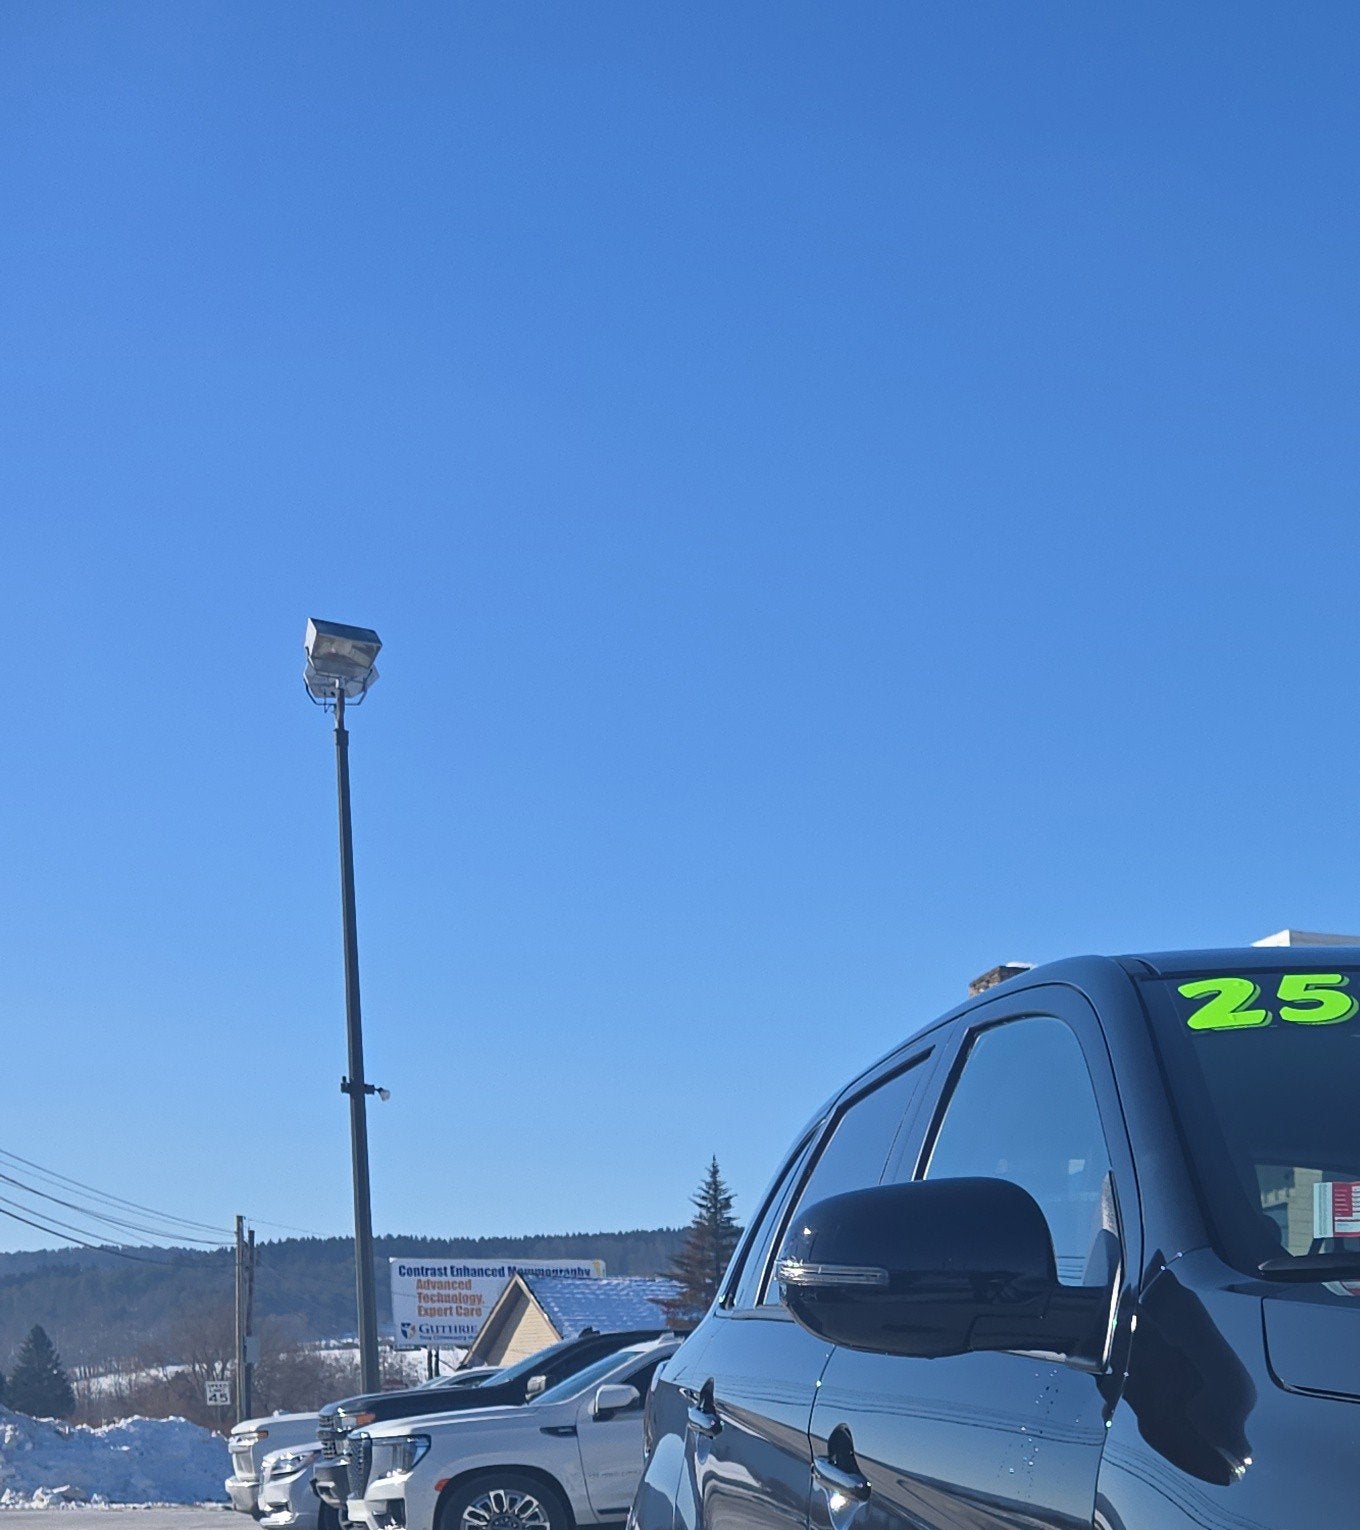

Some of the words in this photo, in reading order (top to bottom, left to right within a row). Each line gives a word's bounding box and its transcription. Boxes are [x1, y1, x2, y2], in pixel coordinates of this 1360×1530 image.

[1178, 973, 1359, 1030] 25
[399, 1265, 448, 1277] Contrast
[450, 1265, 505, 1277] Enhanced
[416, 1279, 472, 1290] Advanced
[417, 1305, 453, 1317] Expert
[455, 1305, 482, 1316] Care
[209, 1393, 228, 1403] 45
